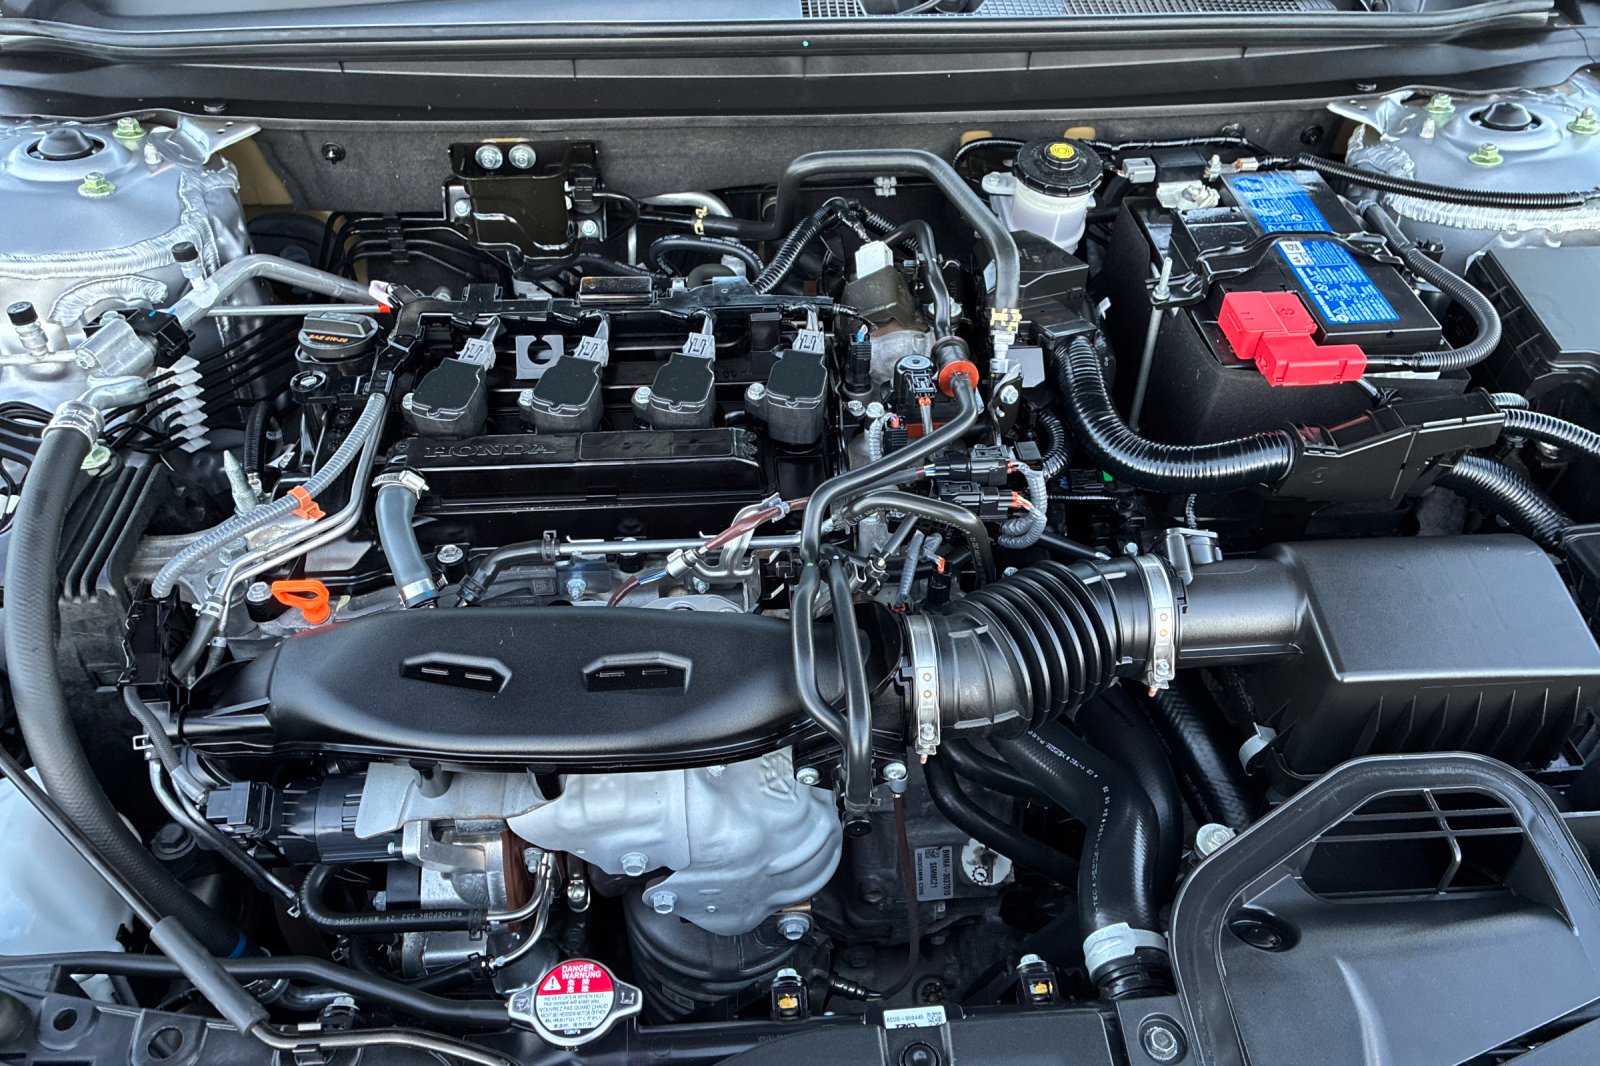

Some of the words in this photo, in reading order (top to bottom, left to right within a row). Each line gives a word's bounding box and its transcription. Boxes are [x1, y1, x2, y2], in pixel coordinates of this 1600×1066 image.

[423, 444, 557, 458] HONDA
[562, 964, 595, 973] DANGER
[562, 971, 601, 980] WARNUNG
